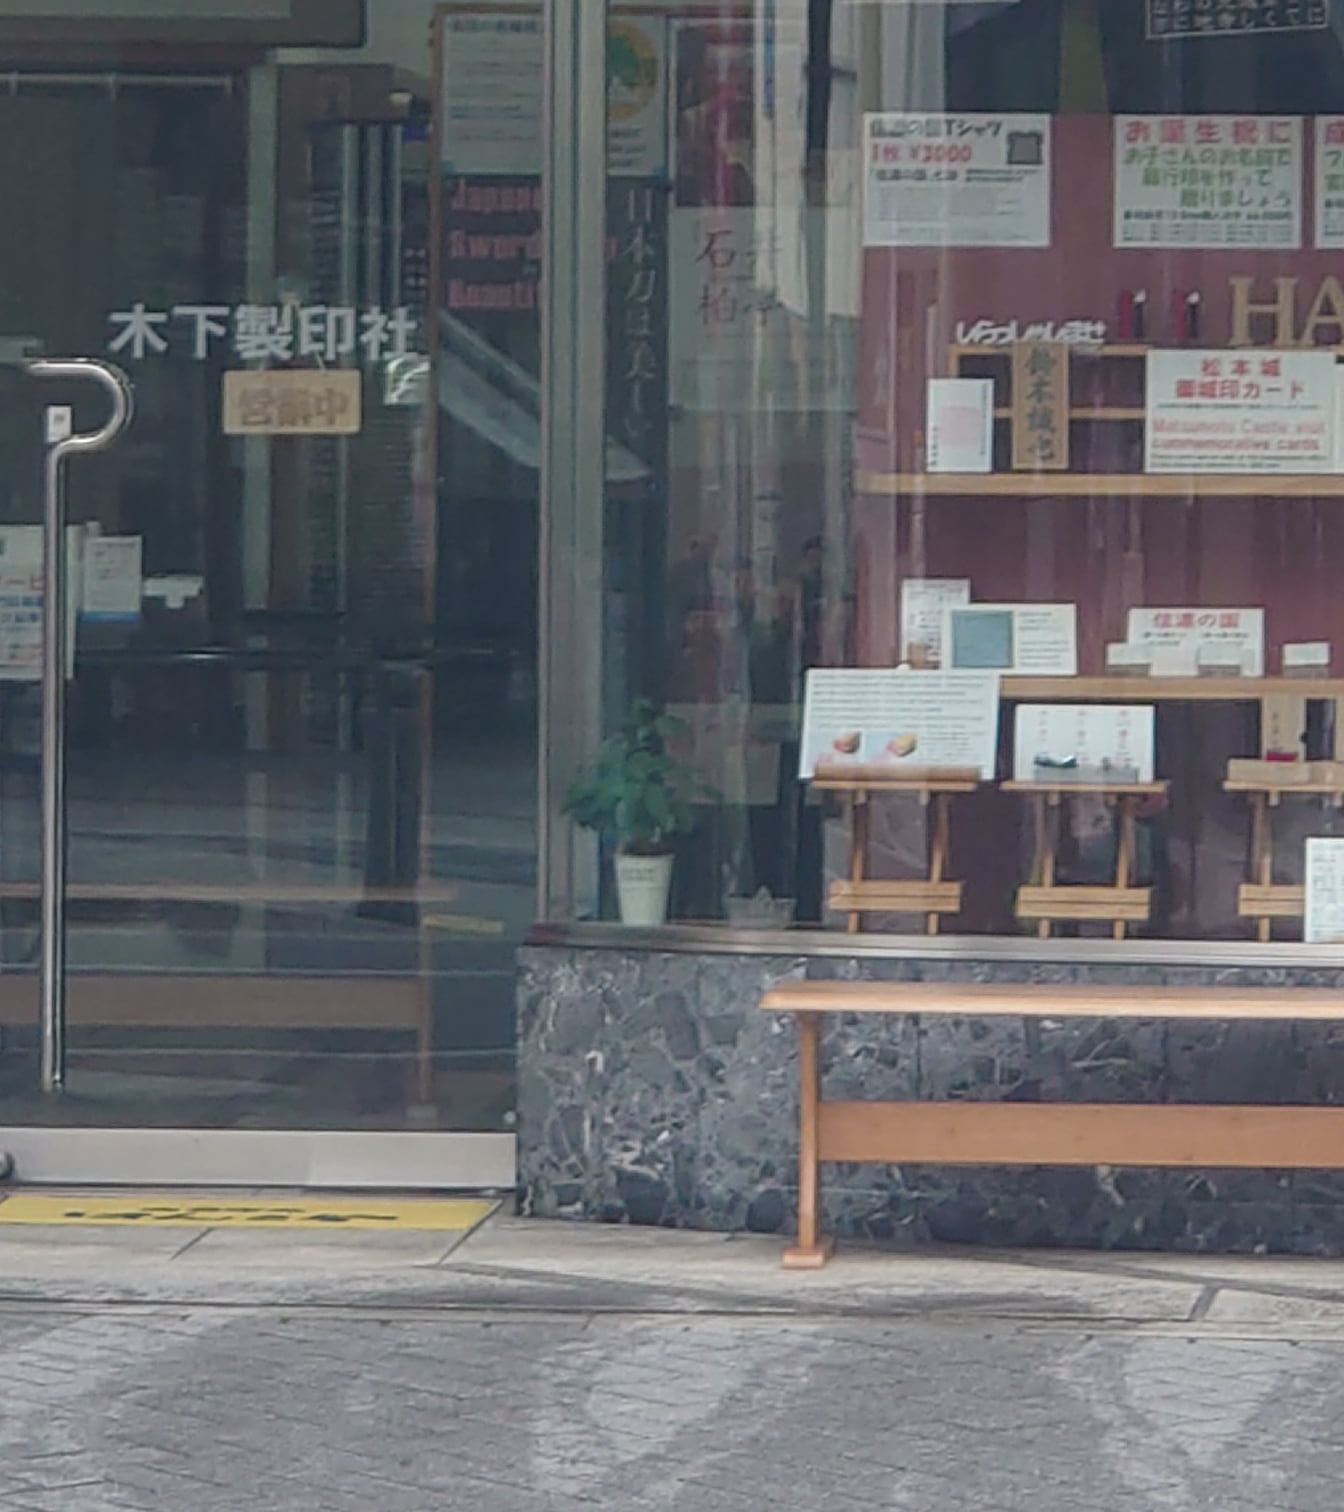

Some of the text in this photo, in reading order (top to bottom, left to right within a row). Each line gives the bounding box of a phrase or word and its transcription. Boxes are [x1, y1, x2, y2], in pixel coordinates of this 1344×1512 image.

[109, 302, 418, 362] 木下製印社
